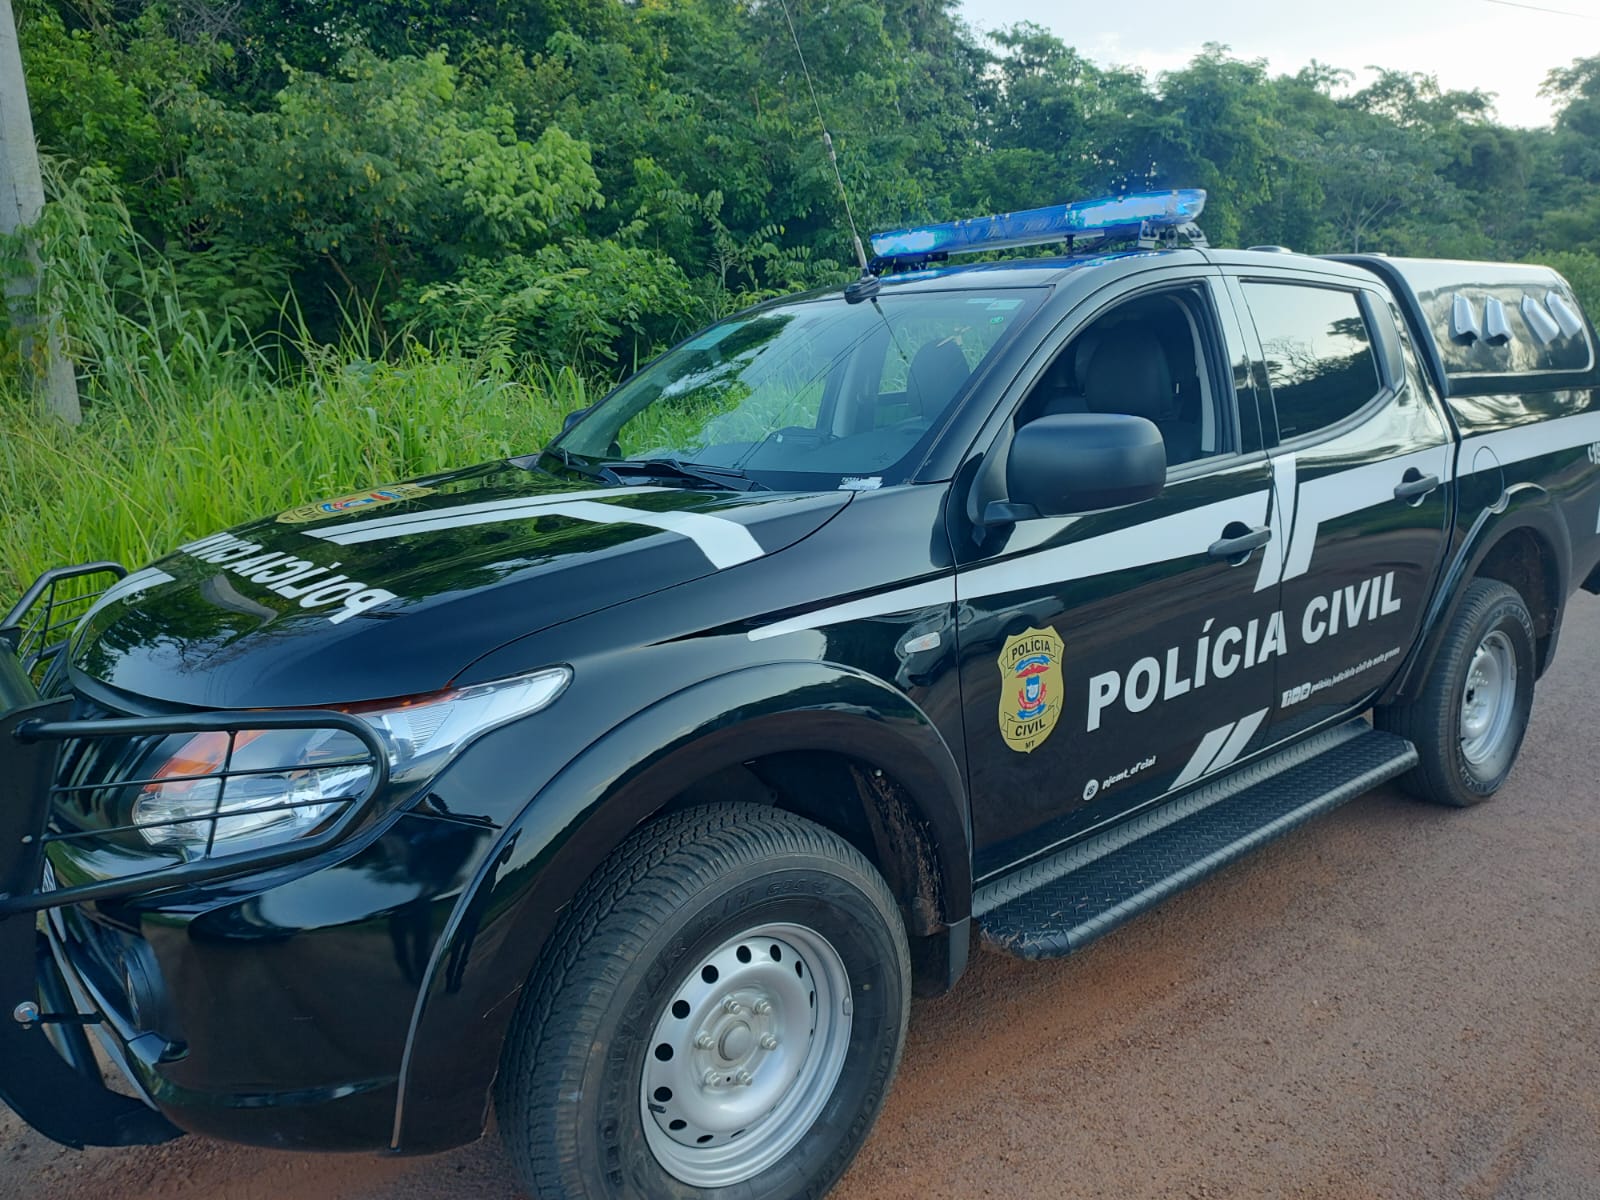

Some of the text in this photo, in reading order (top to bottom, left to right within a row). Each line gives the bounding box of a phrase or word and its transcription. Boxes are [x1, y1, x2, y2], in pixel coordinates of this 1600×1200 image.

[1011, 639, 1051, 660] POLÍCIA
[1086, 571, 1401, 732] POLÍCIA CIVIL
[1015, 719, 1046, 736] CIVIL
